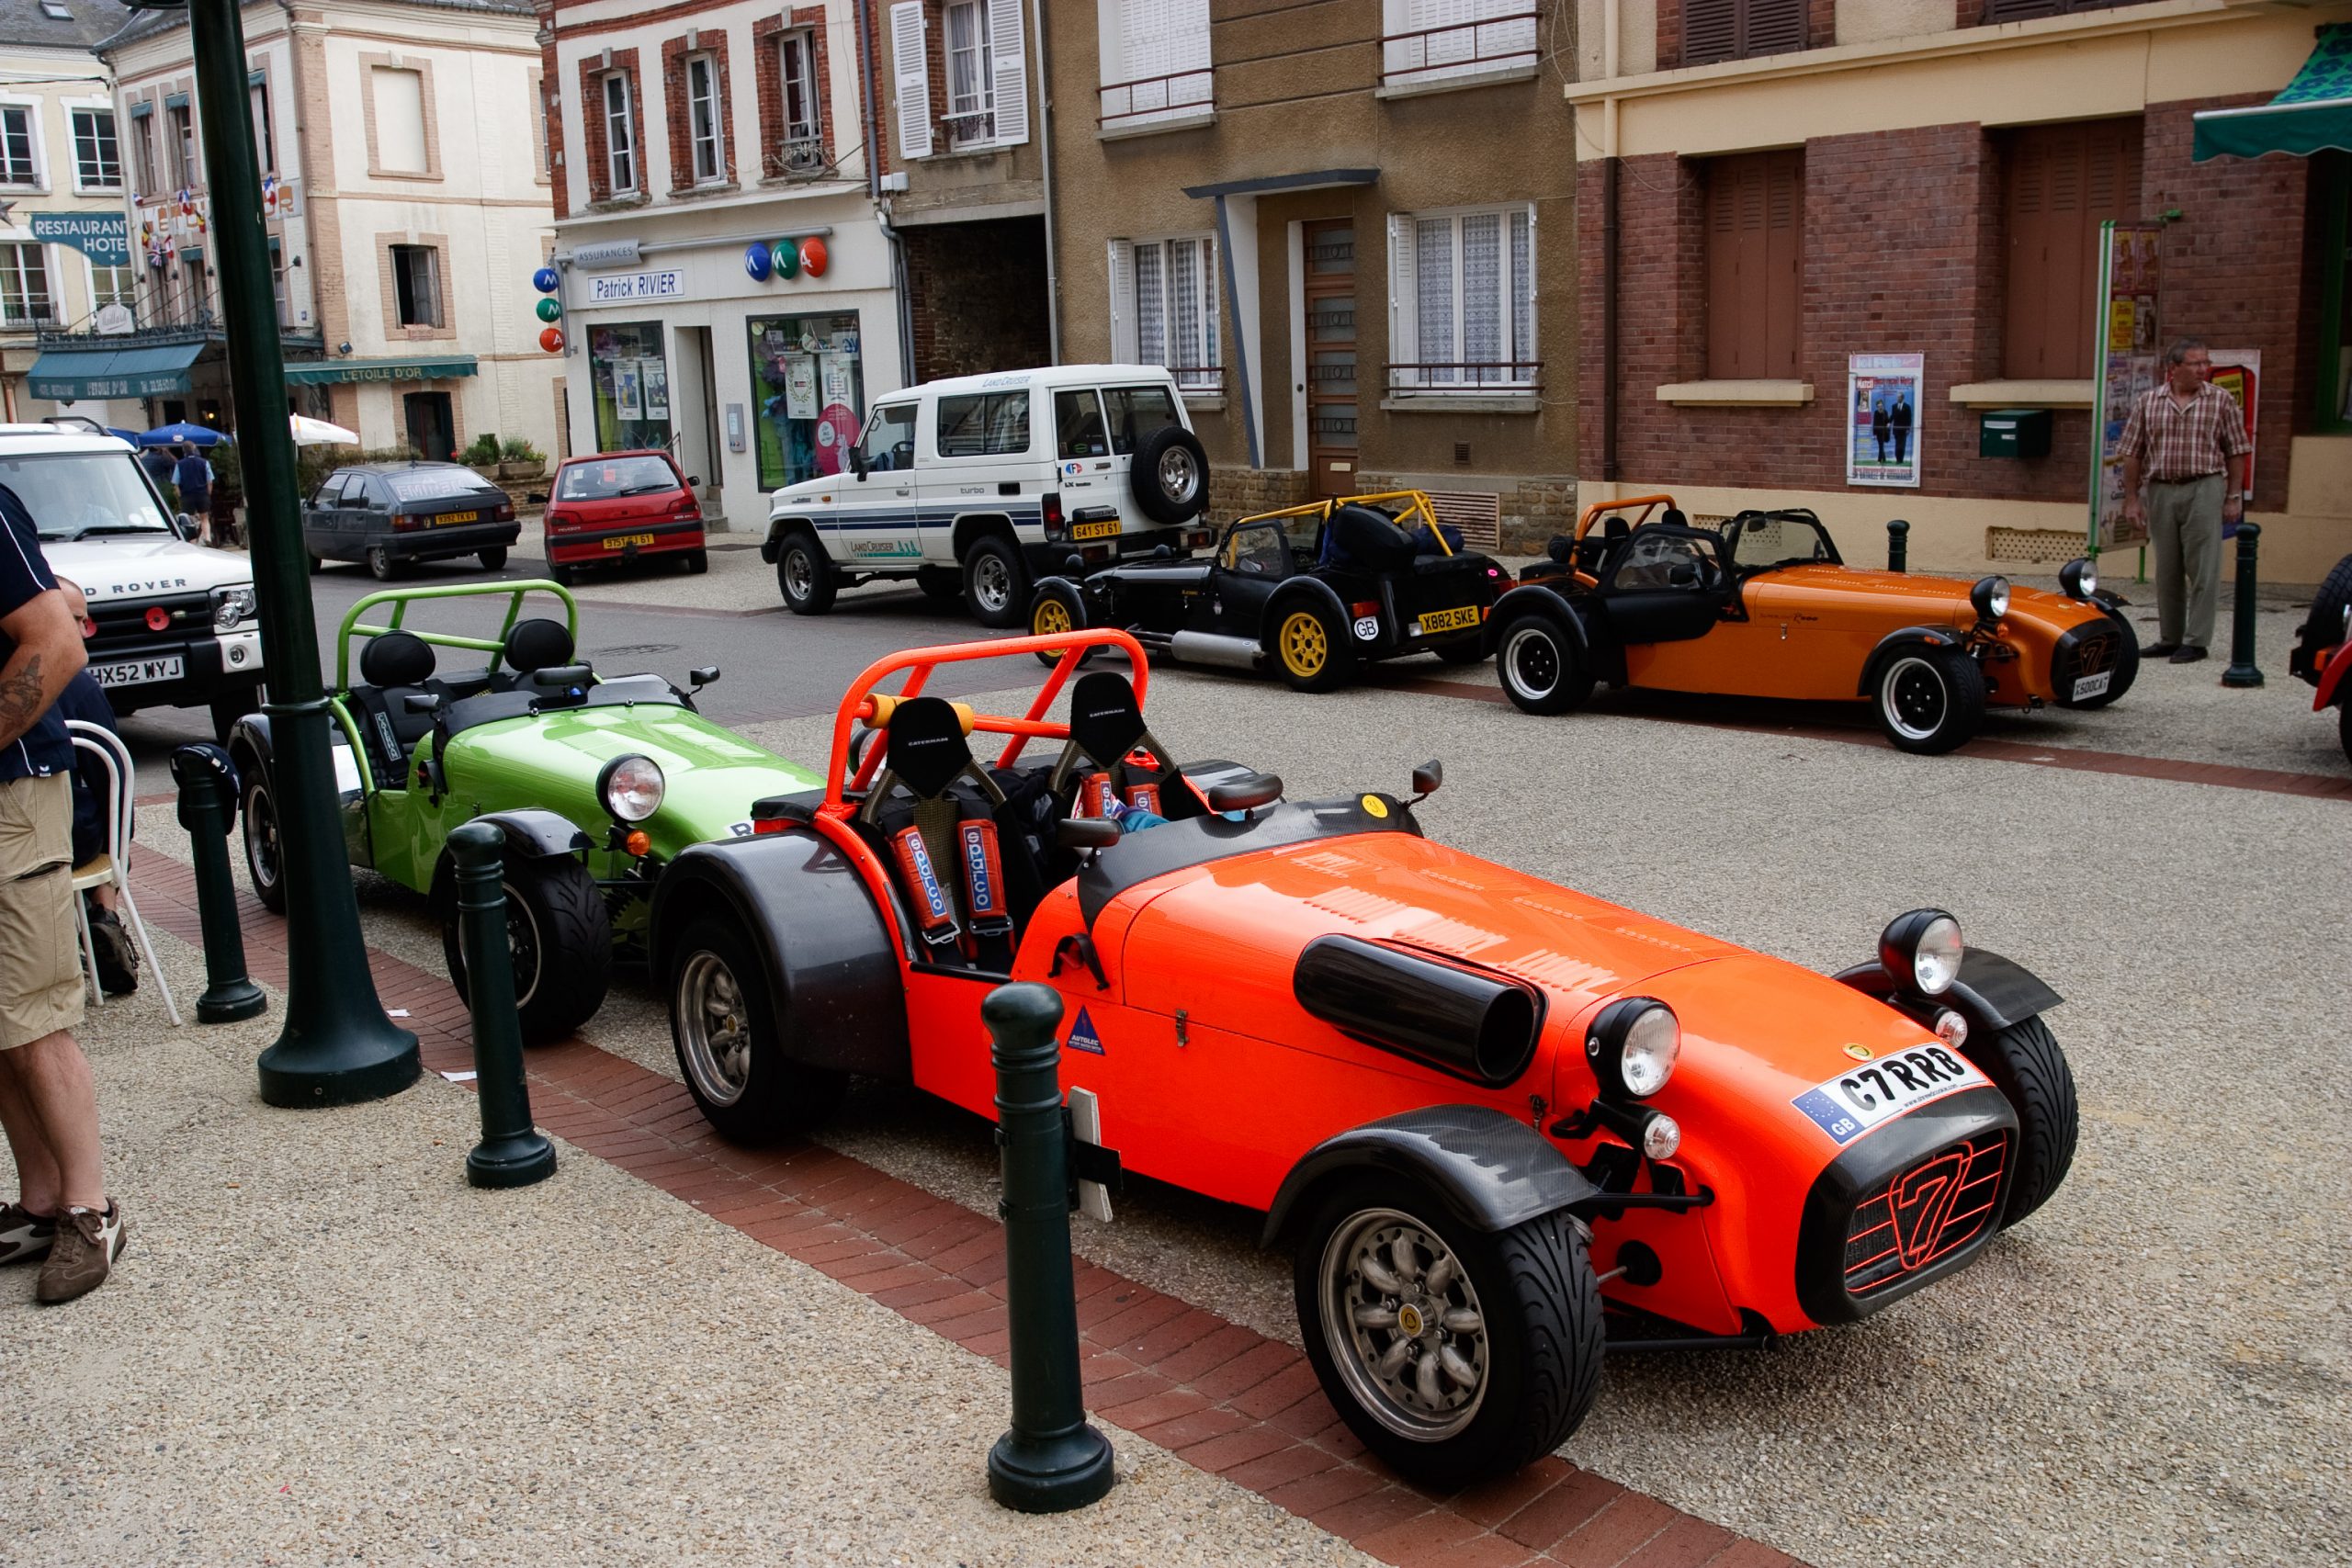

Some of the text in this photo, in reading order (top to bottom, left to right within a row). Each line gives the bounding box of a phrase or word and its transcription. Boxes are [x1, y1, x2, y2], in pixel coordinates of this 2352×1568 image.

[579, 247, 633, 262] ASSURANCES
[597, 273, 675, 299] Patrick RIVIER
[394, 367, 423, 378] D'OR
[1076, 523, 1118, 538] 641 ST 61
[640, 535, 650, 544] 61
[112, 579, 187, 593] ROVER
[1423, 608, 1476, 631] X882 SKE
[1356, 620, 1376, 637] GB
[90, 659, 180, 684] HX52 WYJ
[908, 737, 949, 747] CATERHAM
[1070, 1034, 1100, 1046] AUTOLEC
[1840, 1047, 1965, 1111] C7RRB
[1831, 1117, 1856, 1136] GB
